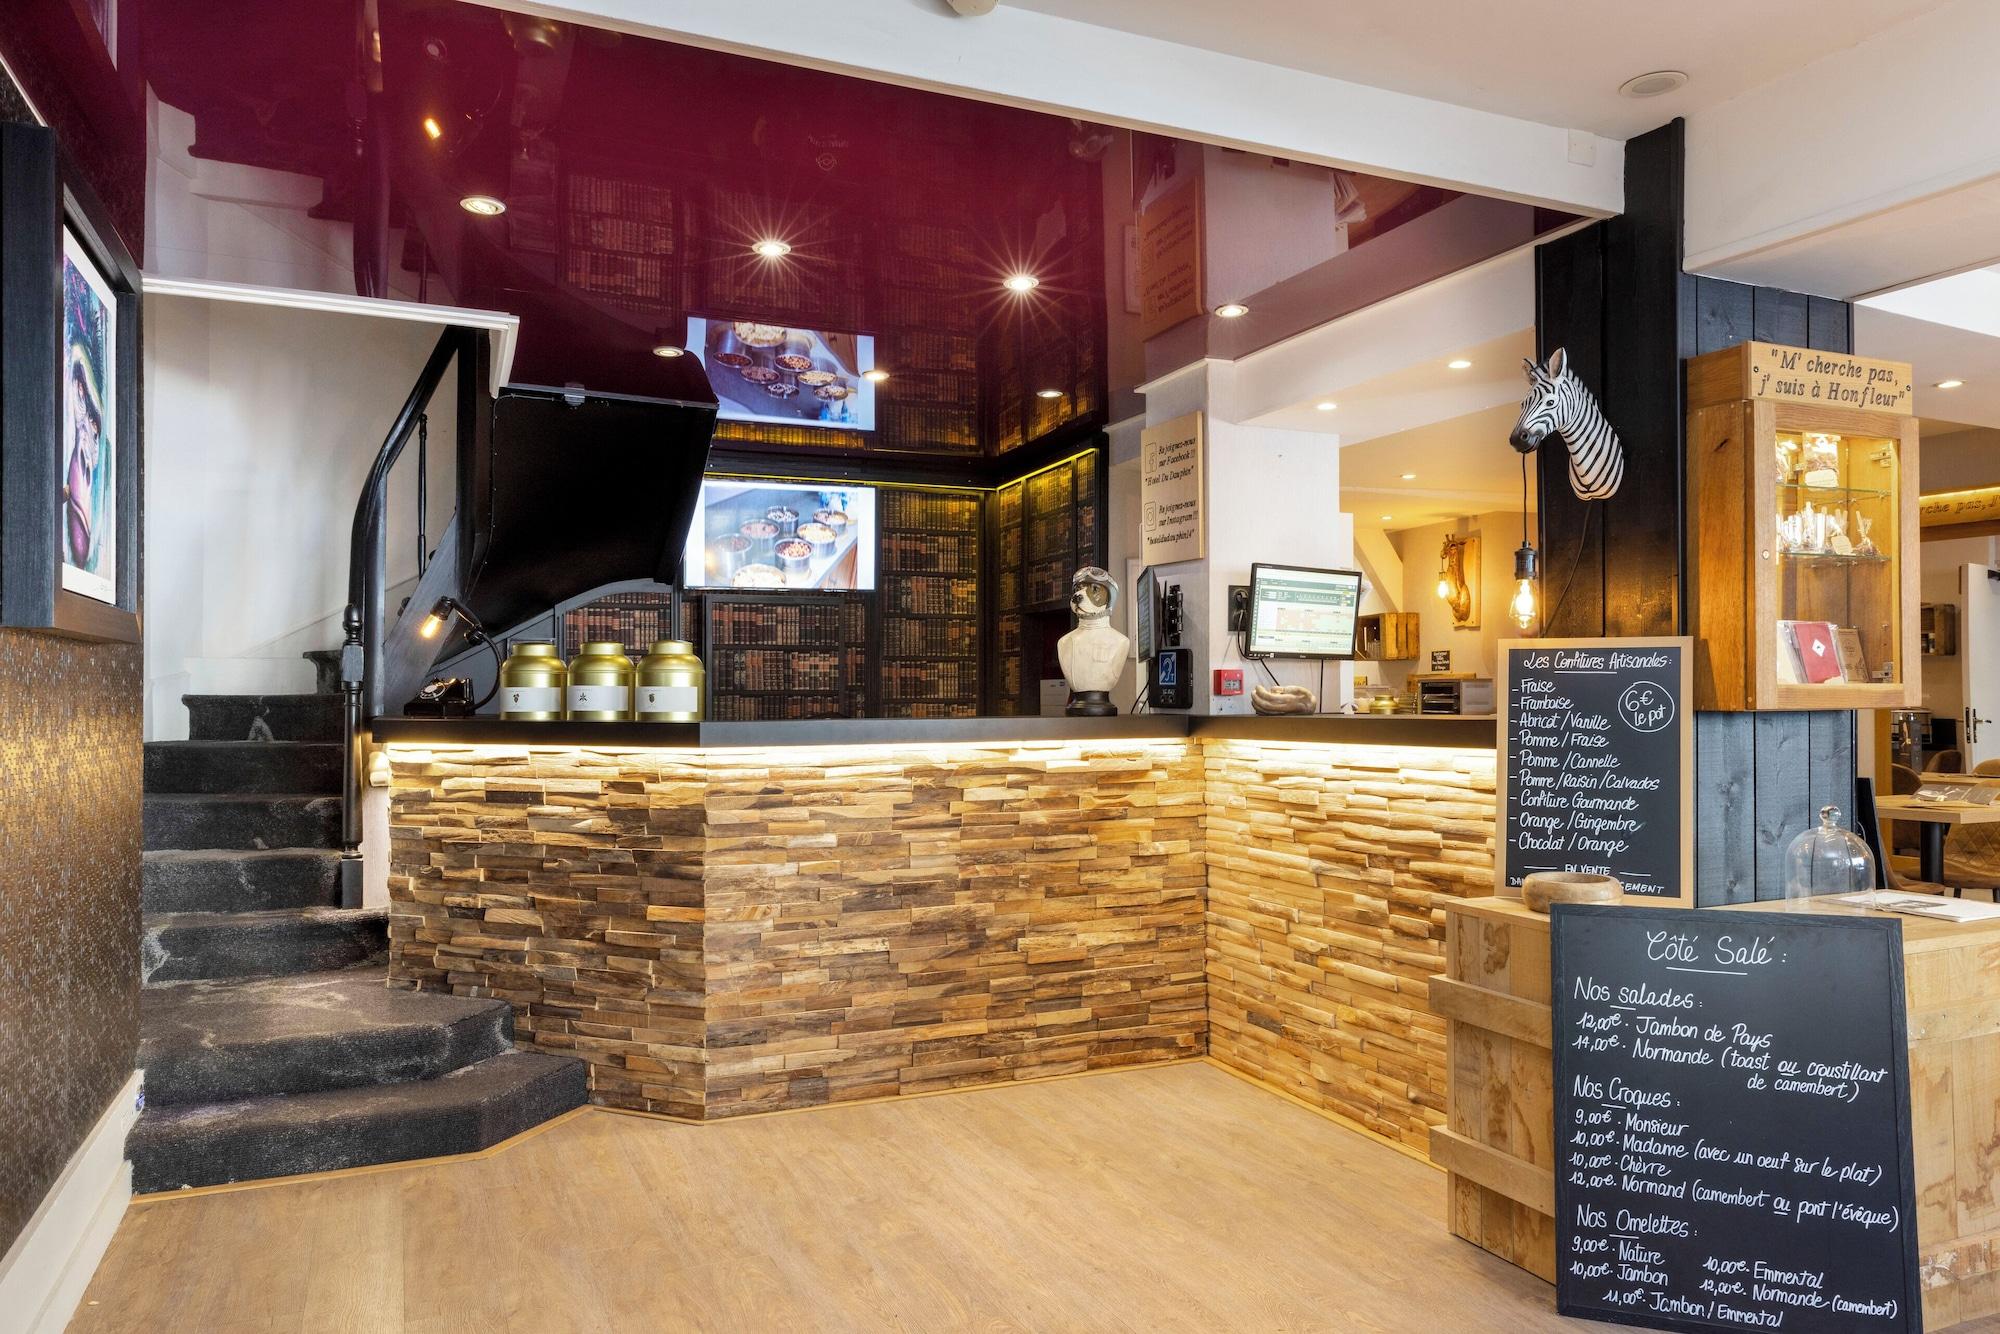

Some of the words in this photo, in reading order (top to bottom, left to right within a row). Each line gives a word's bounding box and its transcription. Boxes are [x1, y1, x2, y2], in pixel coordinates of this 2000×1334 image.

[1806, 355, 1862, 378] cherche
[1867, 366, 1898, 387] pas,
[1757, 373, 1770, 396] j'
[1775, 378, 1805, 396] suis
[1811, 380, 1821, 398] à
[1827, 381, 1905, 408] Honfleur"
[1167, 450, 1190, 465] Facebook
[1524, 652, 1550, 669] Les
[1554, 651, 1604, 670] Confitures
[1521, 678, 1556, 694] Fraise
[1520, 695, 1574, 710] Framboise
[1625, 690, 1654, 711] 6€
[1519, 711, 1560, 729] Abricot
[1634, 711, 1647, 727] le
[1649, 704, 1666, 727] pot
[1519, 729, 1560, 747] Pomme
[1571, 733, 1609, 748] Fraise
[1519, 749, 1560, 768] Pomme
[1520, 788, 1569, 809] Confiture
[1572, 791, 1639, 811] Gourmande
[1519, 811, 1564, 835] Orange
[1519, 831, 1565, 850] Chocolat
[1577, 836, 1629, 858] Orange
[1565, 863, 1578, 873] EN
[1580, 864, 1611, 876] VENTE
[1647, 931, 1698, 962] Côté
[1574, 977, 1610, 1001] Nos
[1636, 1016, 1698, 1039] Jambon
[1704, 1027, 1726, 1042] de
[1731, 1023, 1773, 1052] Pays
[1632, 1038, 1714, 1066] Normande
[1721, 1046, 1772, 1071] (toast
[1777, 1060, 1801, 1074] ou
[1807, 1061, 1888, 1084] croustillant
[1573, 1075, 1603, 1099] Nos
[1747, 1075, 1767, 1090] de
[1774, 1076, 1860, 1103] camembert)
[1625, 1112, 1690, 1137] Monsieur
[1620, 1156, 1672, 1178] Chèvre
[1623, 1133, 1689, 1158] Madame
[1694, 1139, 1730, 1161] (avec
[1733, 1150, 1754, 1166] un
[1757, 1151, 1793, 1171] oeuf
[1794, 1158, 1820, 1175] sur
[1821, 1156, 1839, 1178] le
[1839, 1161, 1882, 1187] plat)
[1622, 1174, 1686, 1200] Normand
[1692, 1179, 1771, 1208] (camembert
[1774, 1196, 1792, 1211] ou
[1797, 1198, 1834, 1224] pont
[1832, 1201, 1900, 1233] l'évêque)
[1576, 1204, 1607, 1229] Nos
[1618, 1240, 1665, 1266] Nature
[1617, 1264, 1668, 1287] Jambon
[1753, 1261, 1825, 1289] Emmental
[1650, 1292, 1705, 1317] Jambon
[1717, 1305, 1784, 1328] Emmental
[1752, 1284, 1831, 1309] Normande
[1831, 1294, 1898, 1319] (camembert)
